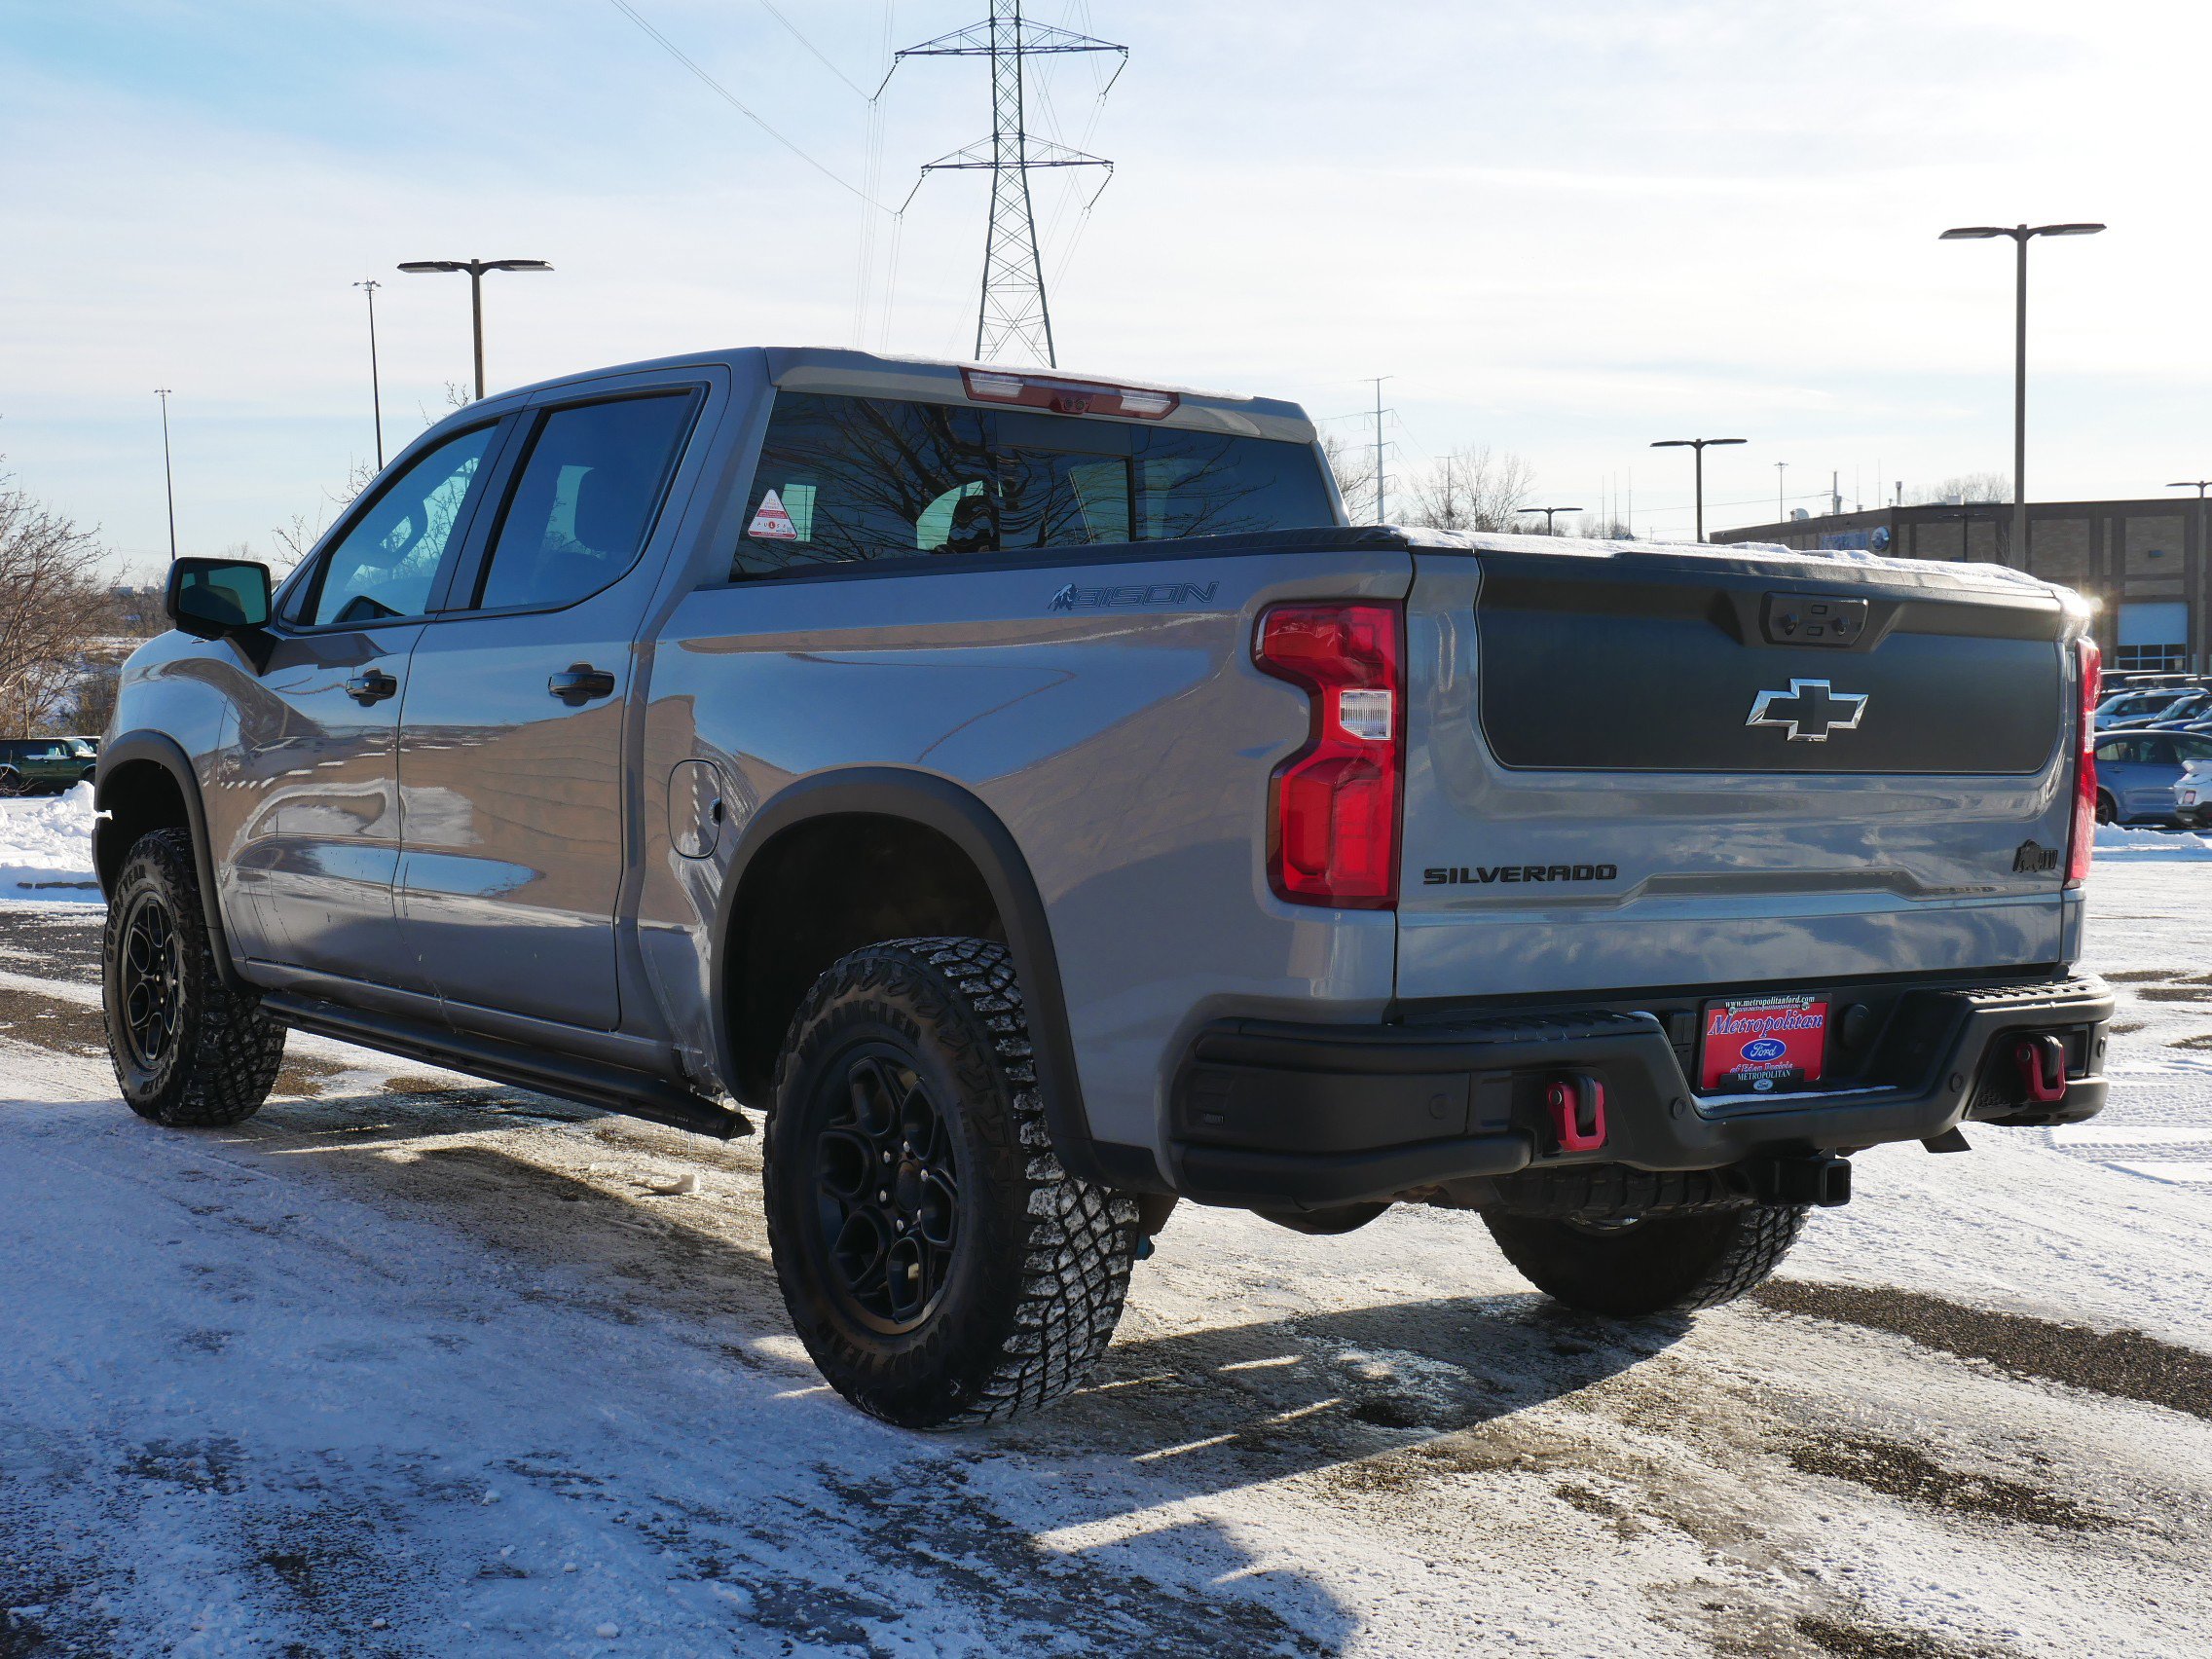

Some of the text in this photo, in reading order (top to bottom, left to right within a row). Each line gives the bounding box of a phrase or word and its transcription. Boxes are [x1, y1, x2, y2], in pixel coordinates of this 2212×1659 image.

[1071, 581, 1220, 608] BISON
[1423, 864, 1617, 885] SILVERADO
[1725, 995, 1815, 1009] www.metropolitanford.com
[1707, 1009, 1824, 1038] Metropolitan
[1750, 1042, 1778, 1057] Ford
[1737, 1069, 1791, 1082] METROPOLITAN
